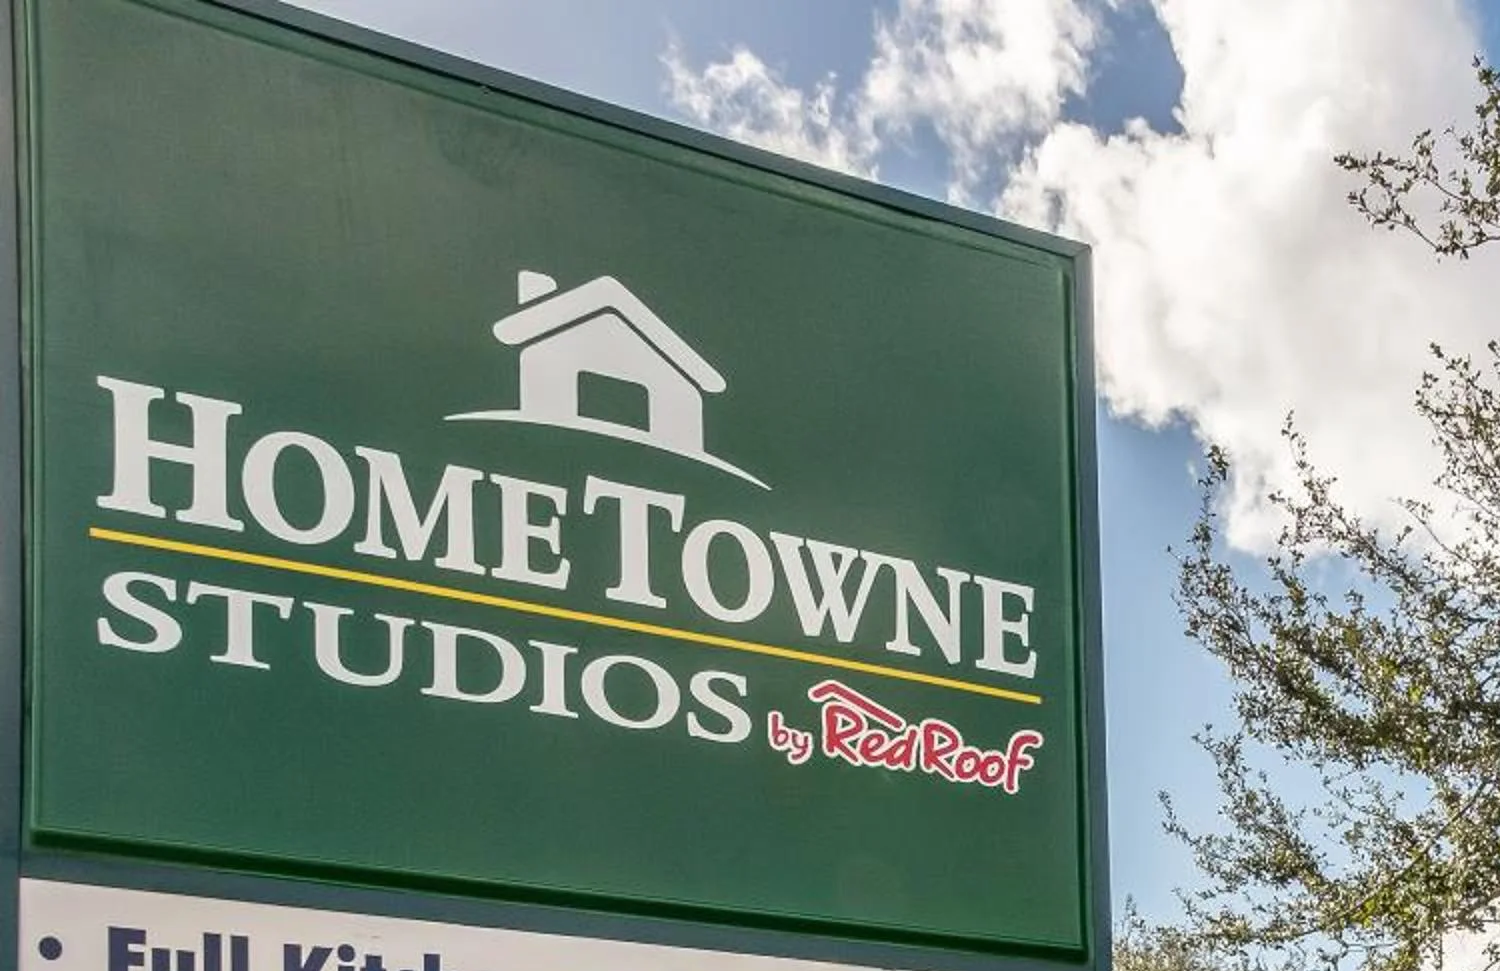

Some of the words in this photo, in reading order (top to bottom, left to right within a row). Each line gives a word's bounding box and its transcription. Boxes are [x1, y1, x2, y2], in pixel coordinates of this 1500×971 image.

[96, 375, 1038, 678] HOMETOWNE
[97, 571, 752, 743] STUDIOS
[768, 711, 812, 764] by
